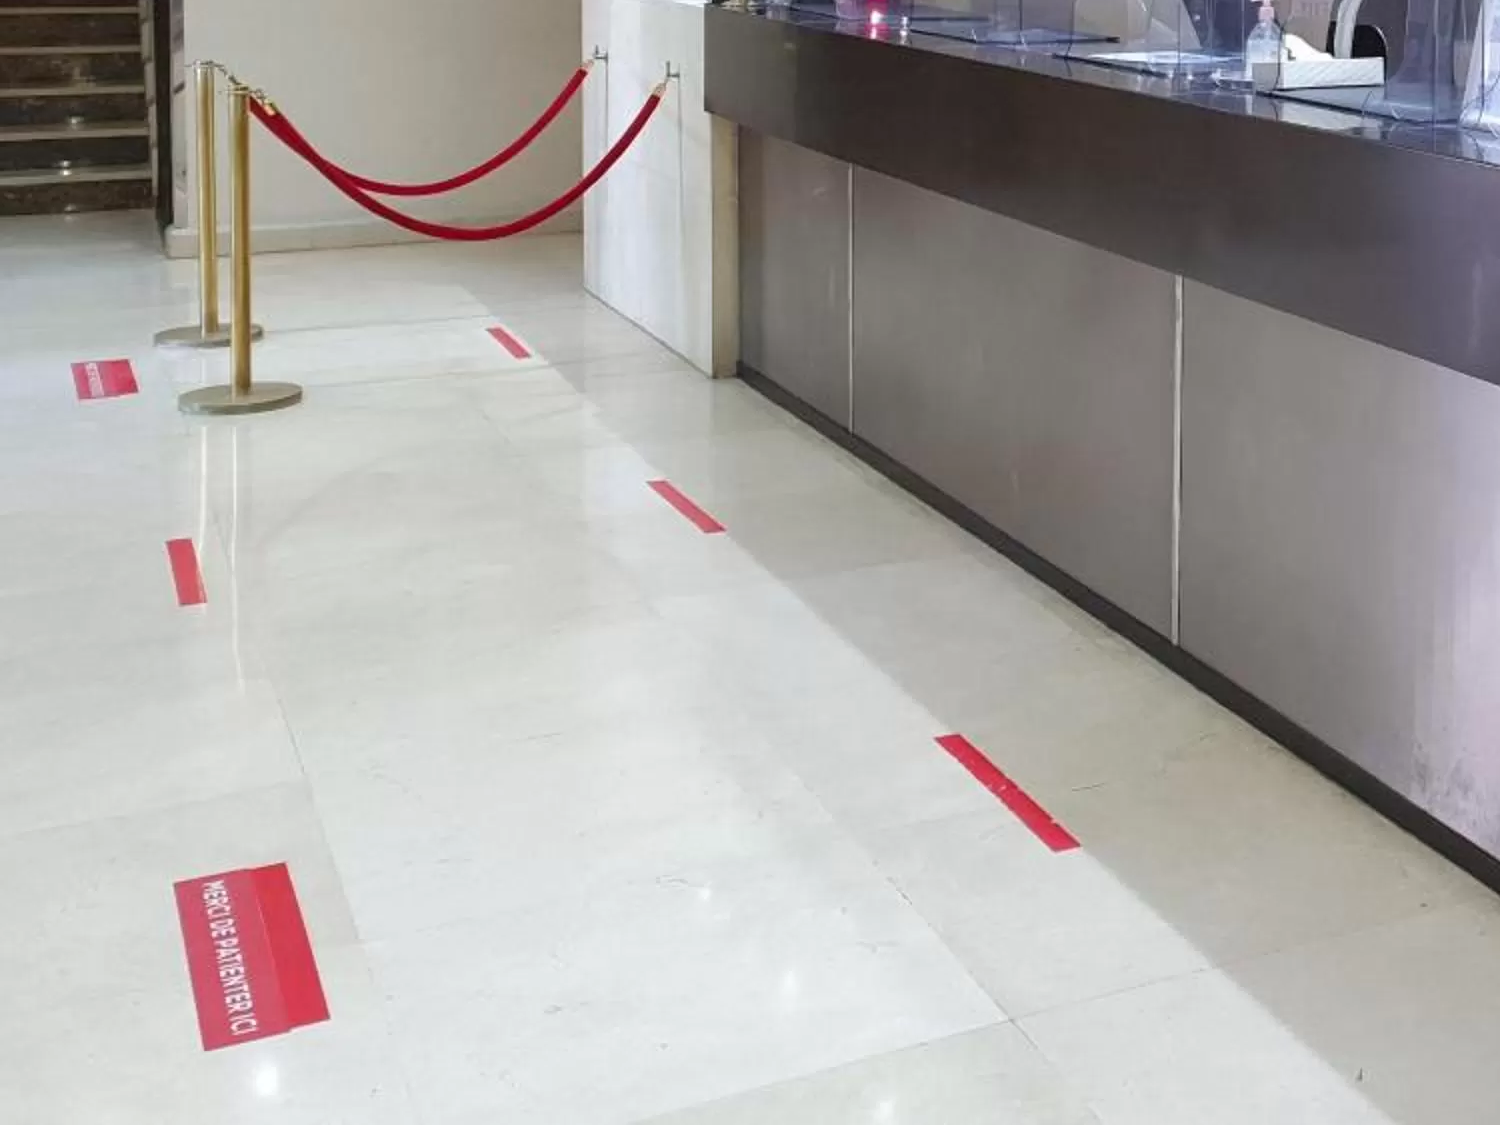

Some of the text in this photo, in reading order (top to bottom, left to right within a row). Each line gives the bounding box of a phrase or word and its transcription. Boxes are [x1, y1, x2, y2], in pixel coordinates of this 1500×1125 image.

[202, 879, 258, 1036] MERCI DE PATIENTER ICI
